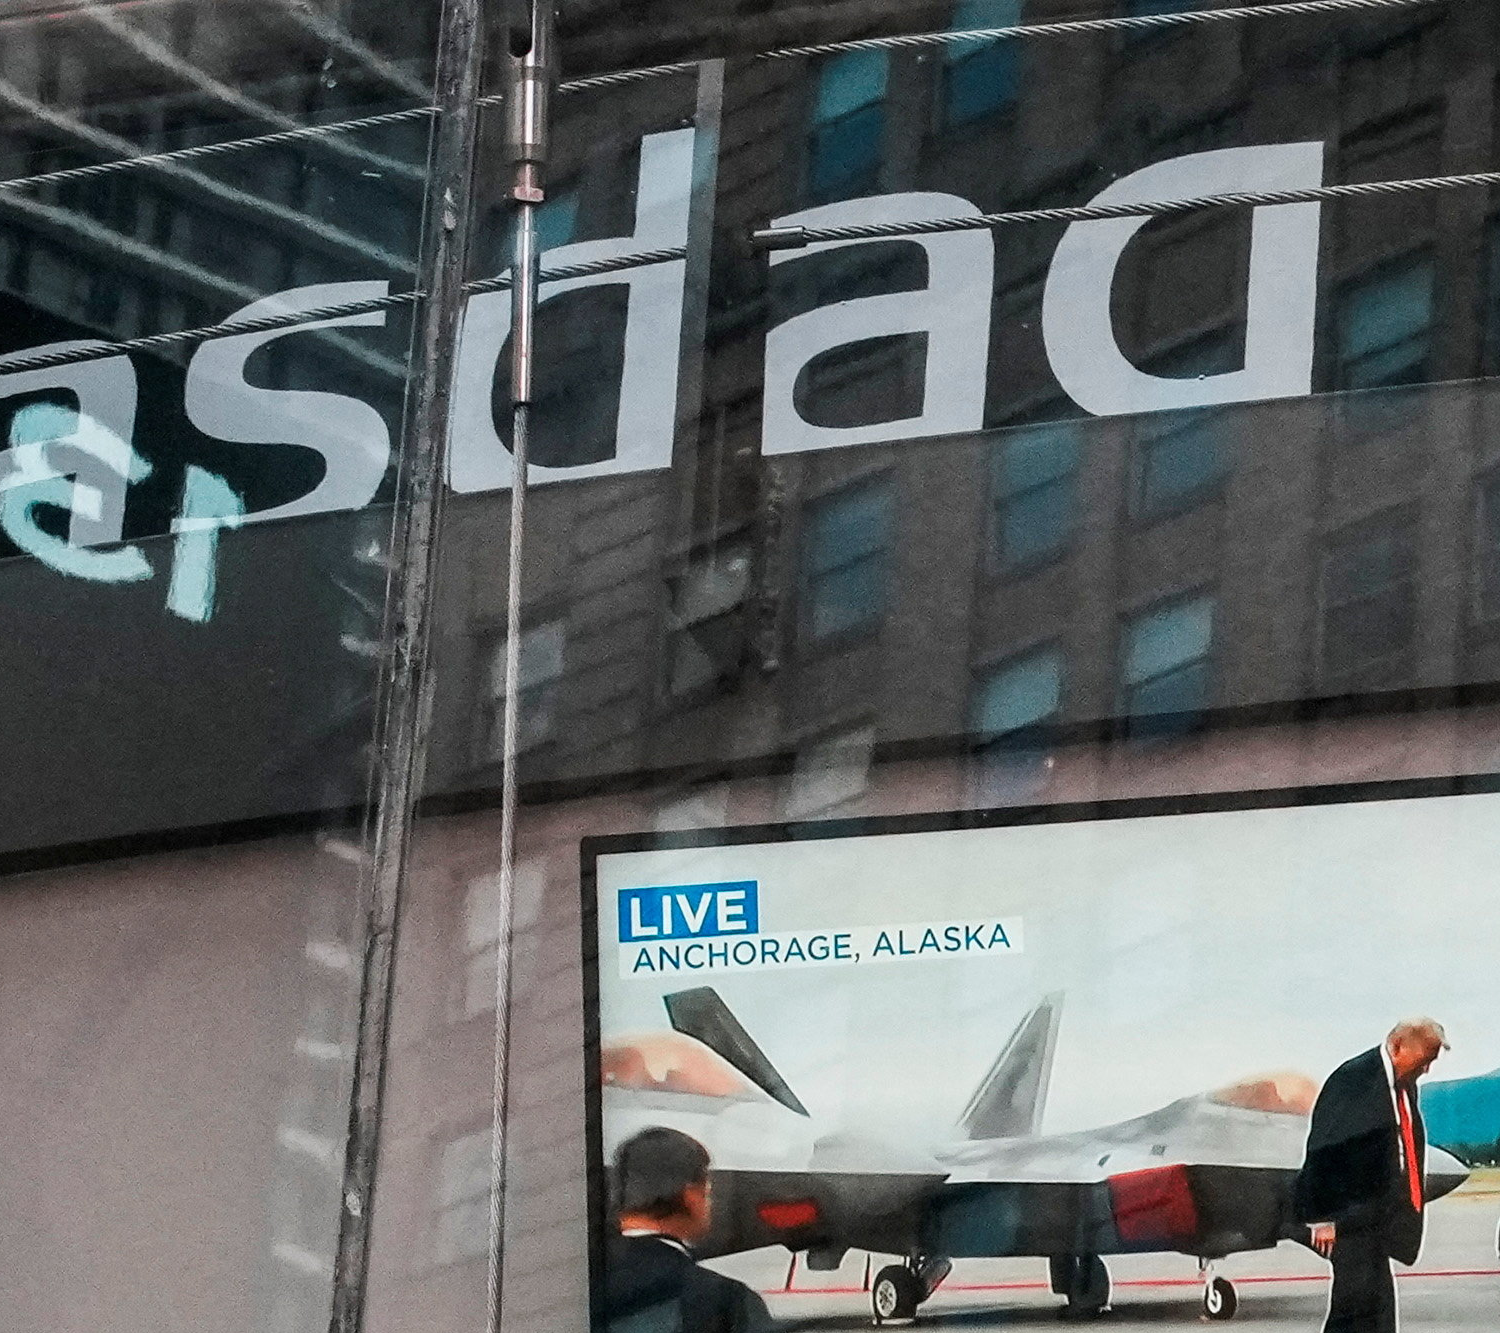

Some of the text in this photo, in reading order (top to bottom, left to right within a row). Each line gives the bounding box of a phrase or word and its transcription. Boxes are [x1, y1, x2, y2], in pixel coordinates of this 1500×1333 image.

[629, 890, 747, 937] LIVE
[633, 923, 1012, 974] ANCHORAGE, ALASKA
